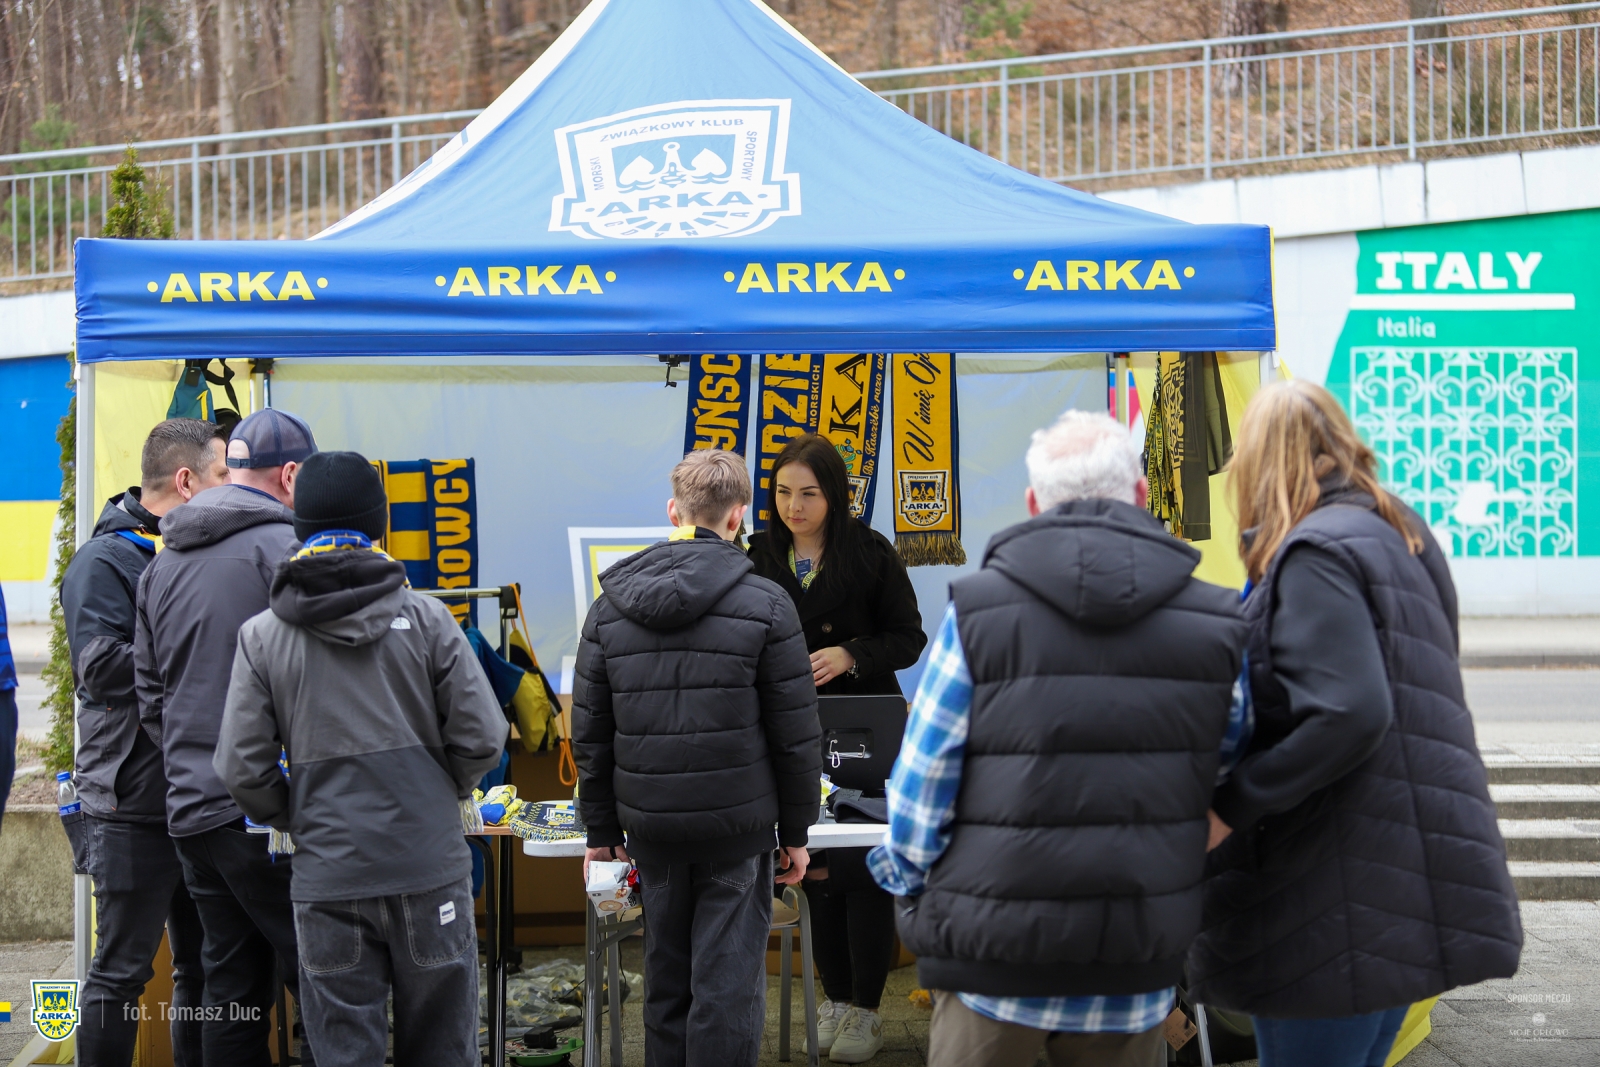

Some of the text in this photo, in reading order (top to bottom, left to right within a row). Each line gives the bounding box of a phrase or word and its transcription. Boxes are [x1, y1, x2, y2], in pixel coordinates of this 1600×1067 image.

[599, 118, 745, 143] ZWIĄZKOWY KLUB
[741, 130, 758, 181] SPORTOWY
[590, 156, 605, 191] MORSKI
[597, 191, 754, 218] ARKA
[160, 270, 315, 303] ARKA
[447, 264, 604, 297] ARKA
[736, 262, 892, 293] ARKA
[1025, 259, 1182, 291] ARKA
[1375, 251, 1544, 290] ITALY
[1377, 316, 1437, 338] Italia
[810, 364, 821, 427] MORSKICH
